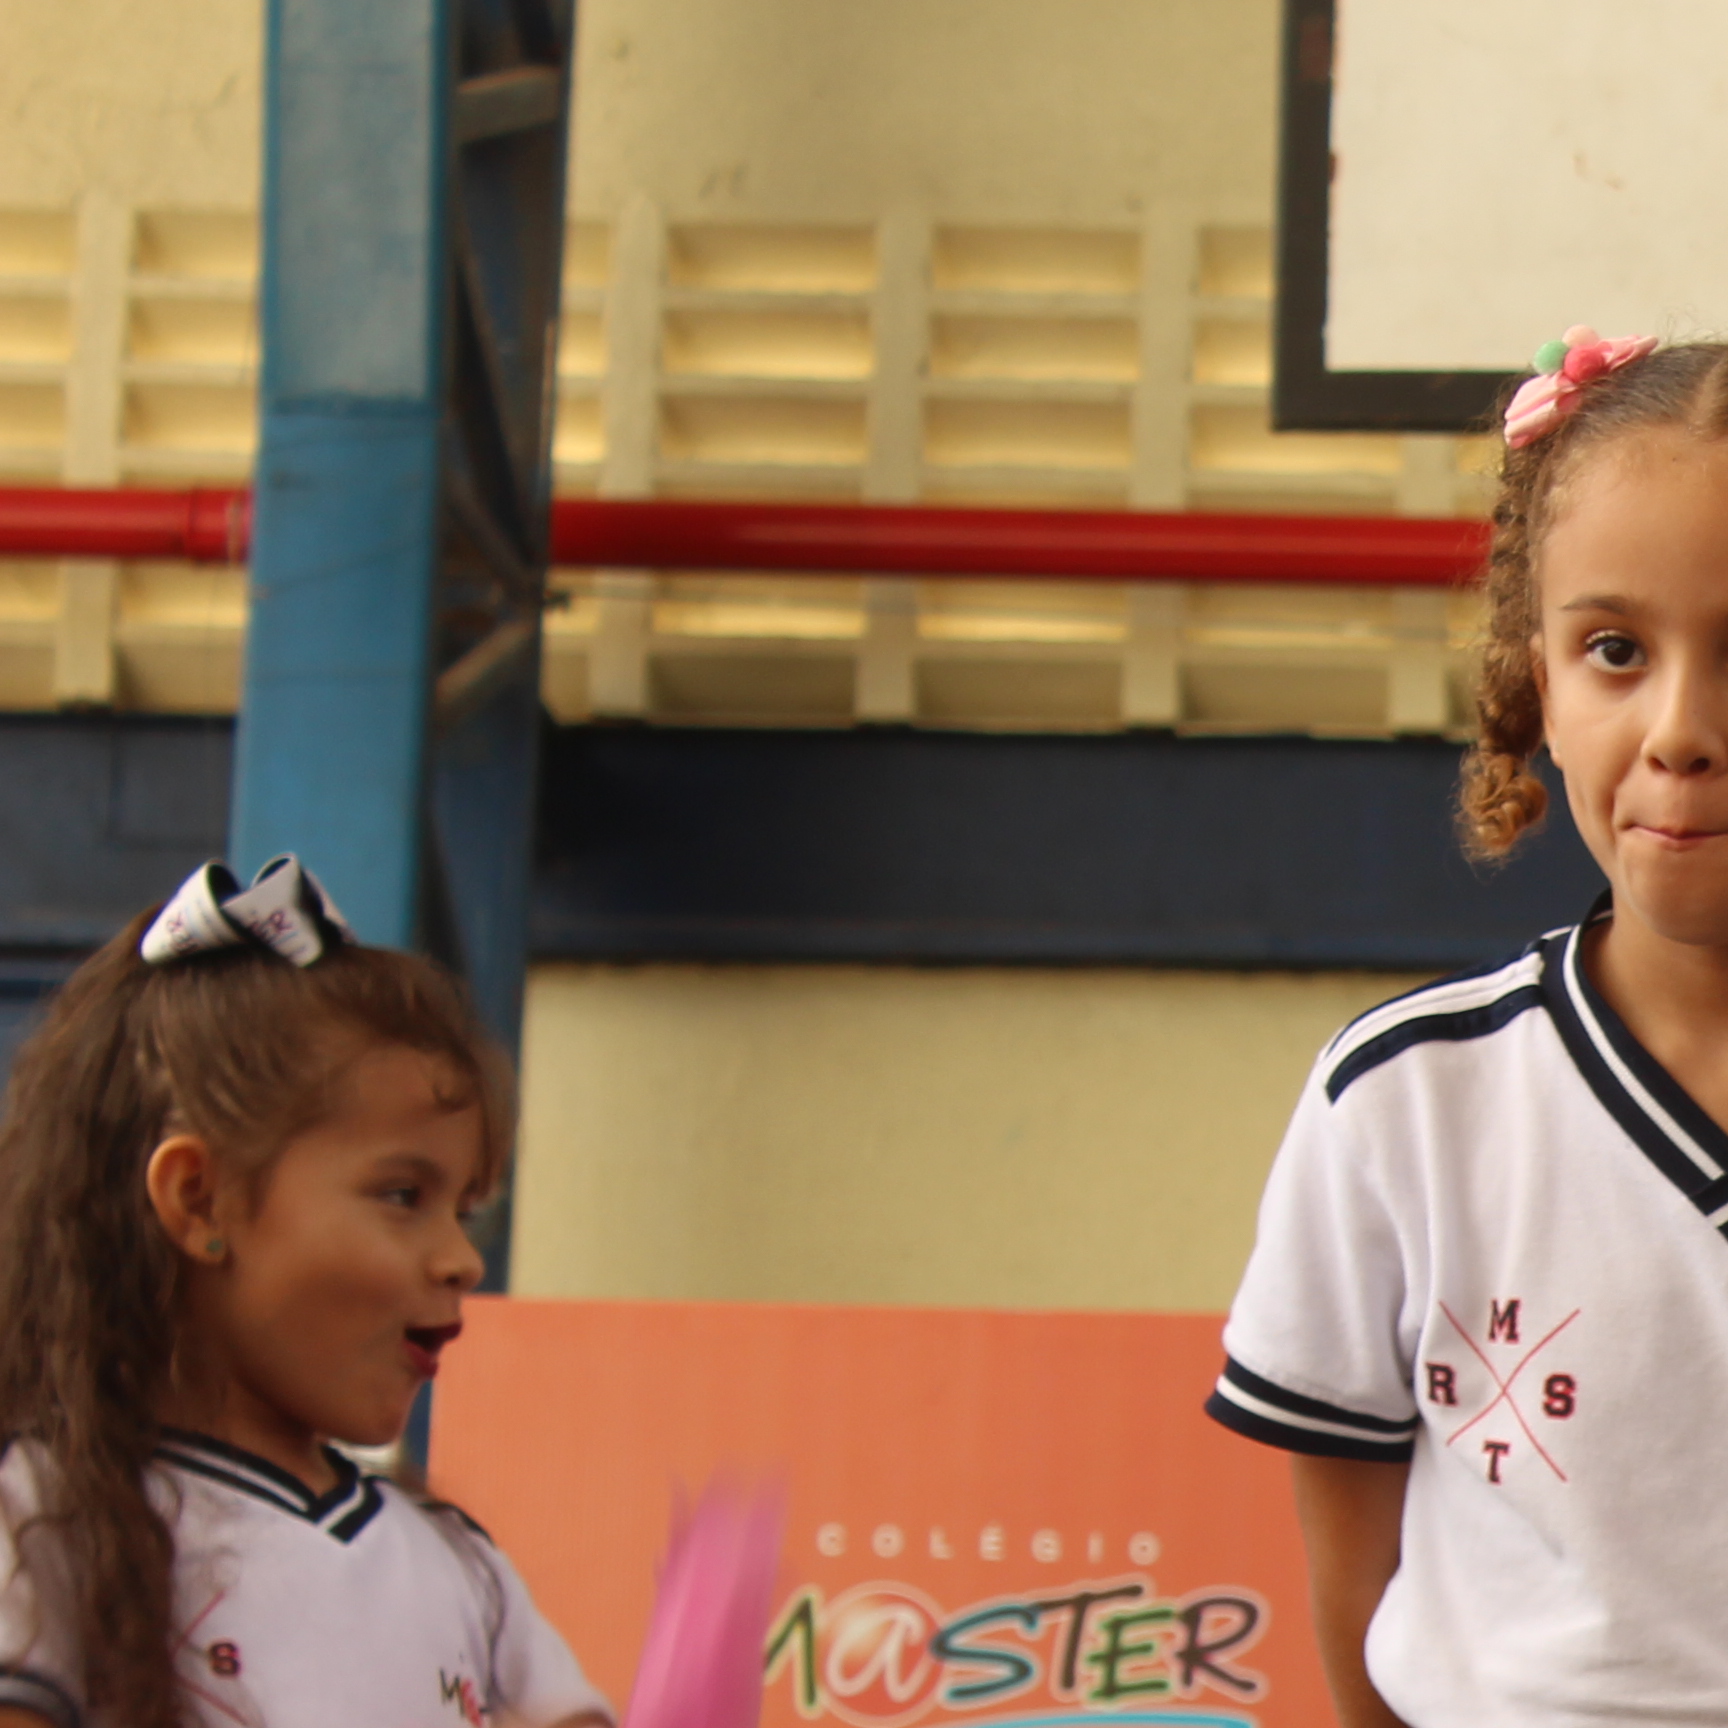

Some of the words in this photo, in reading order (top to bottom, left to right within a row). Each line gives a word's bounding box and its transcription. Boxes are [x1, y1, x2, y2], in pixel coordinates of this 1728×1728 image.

[1488, 1297, 1521, 1344] M
[1426, 1362, 1459, 1408] R
[1542, 1373, 1577, 1421] S
[1482, 1439, 1511, 1485] T
[816, 1520, 1163, 1566] COLÉGIO
